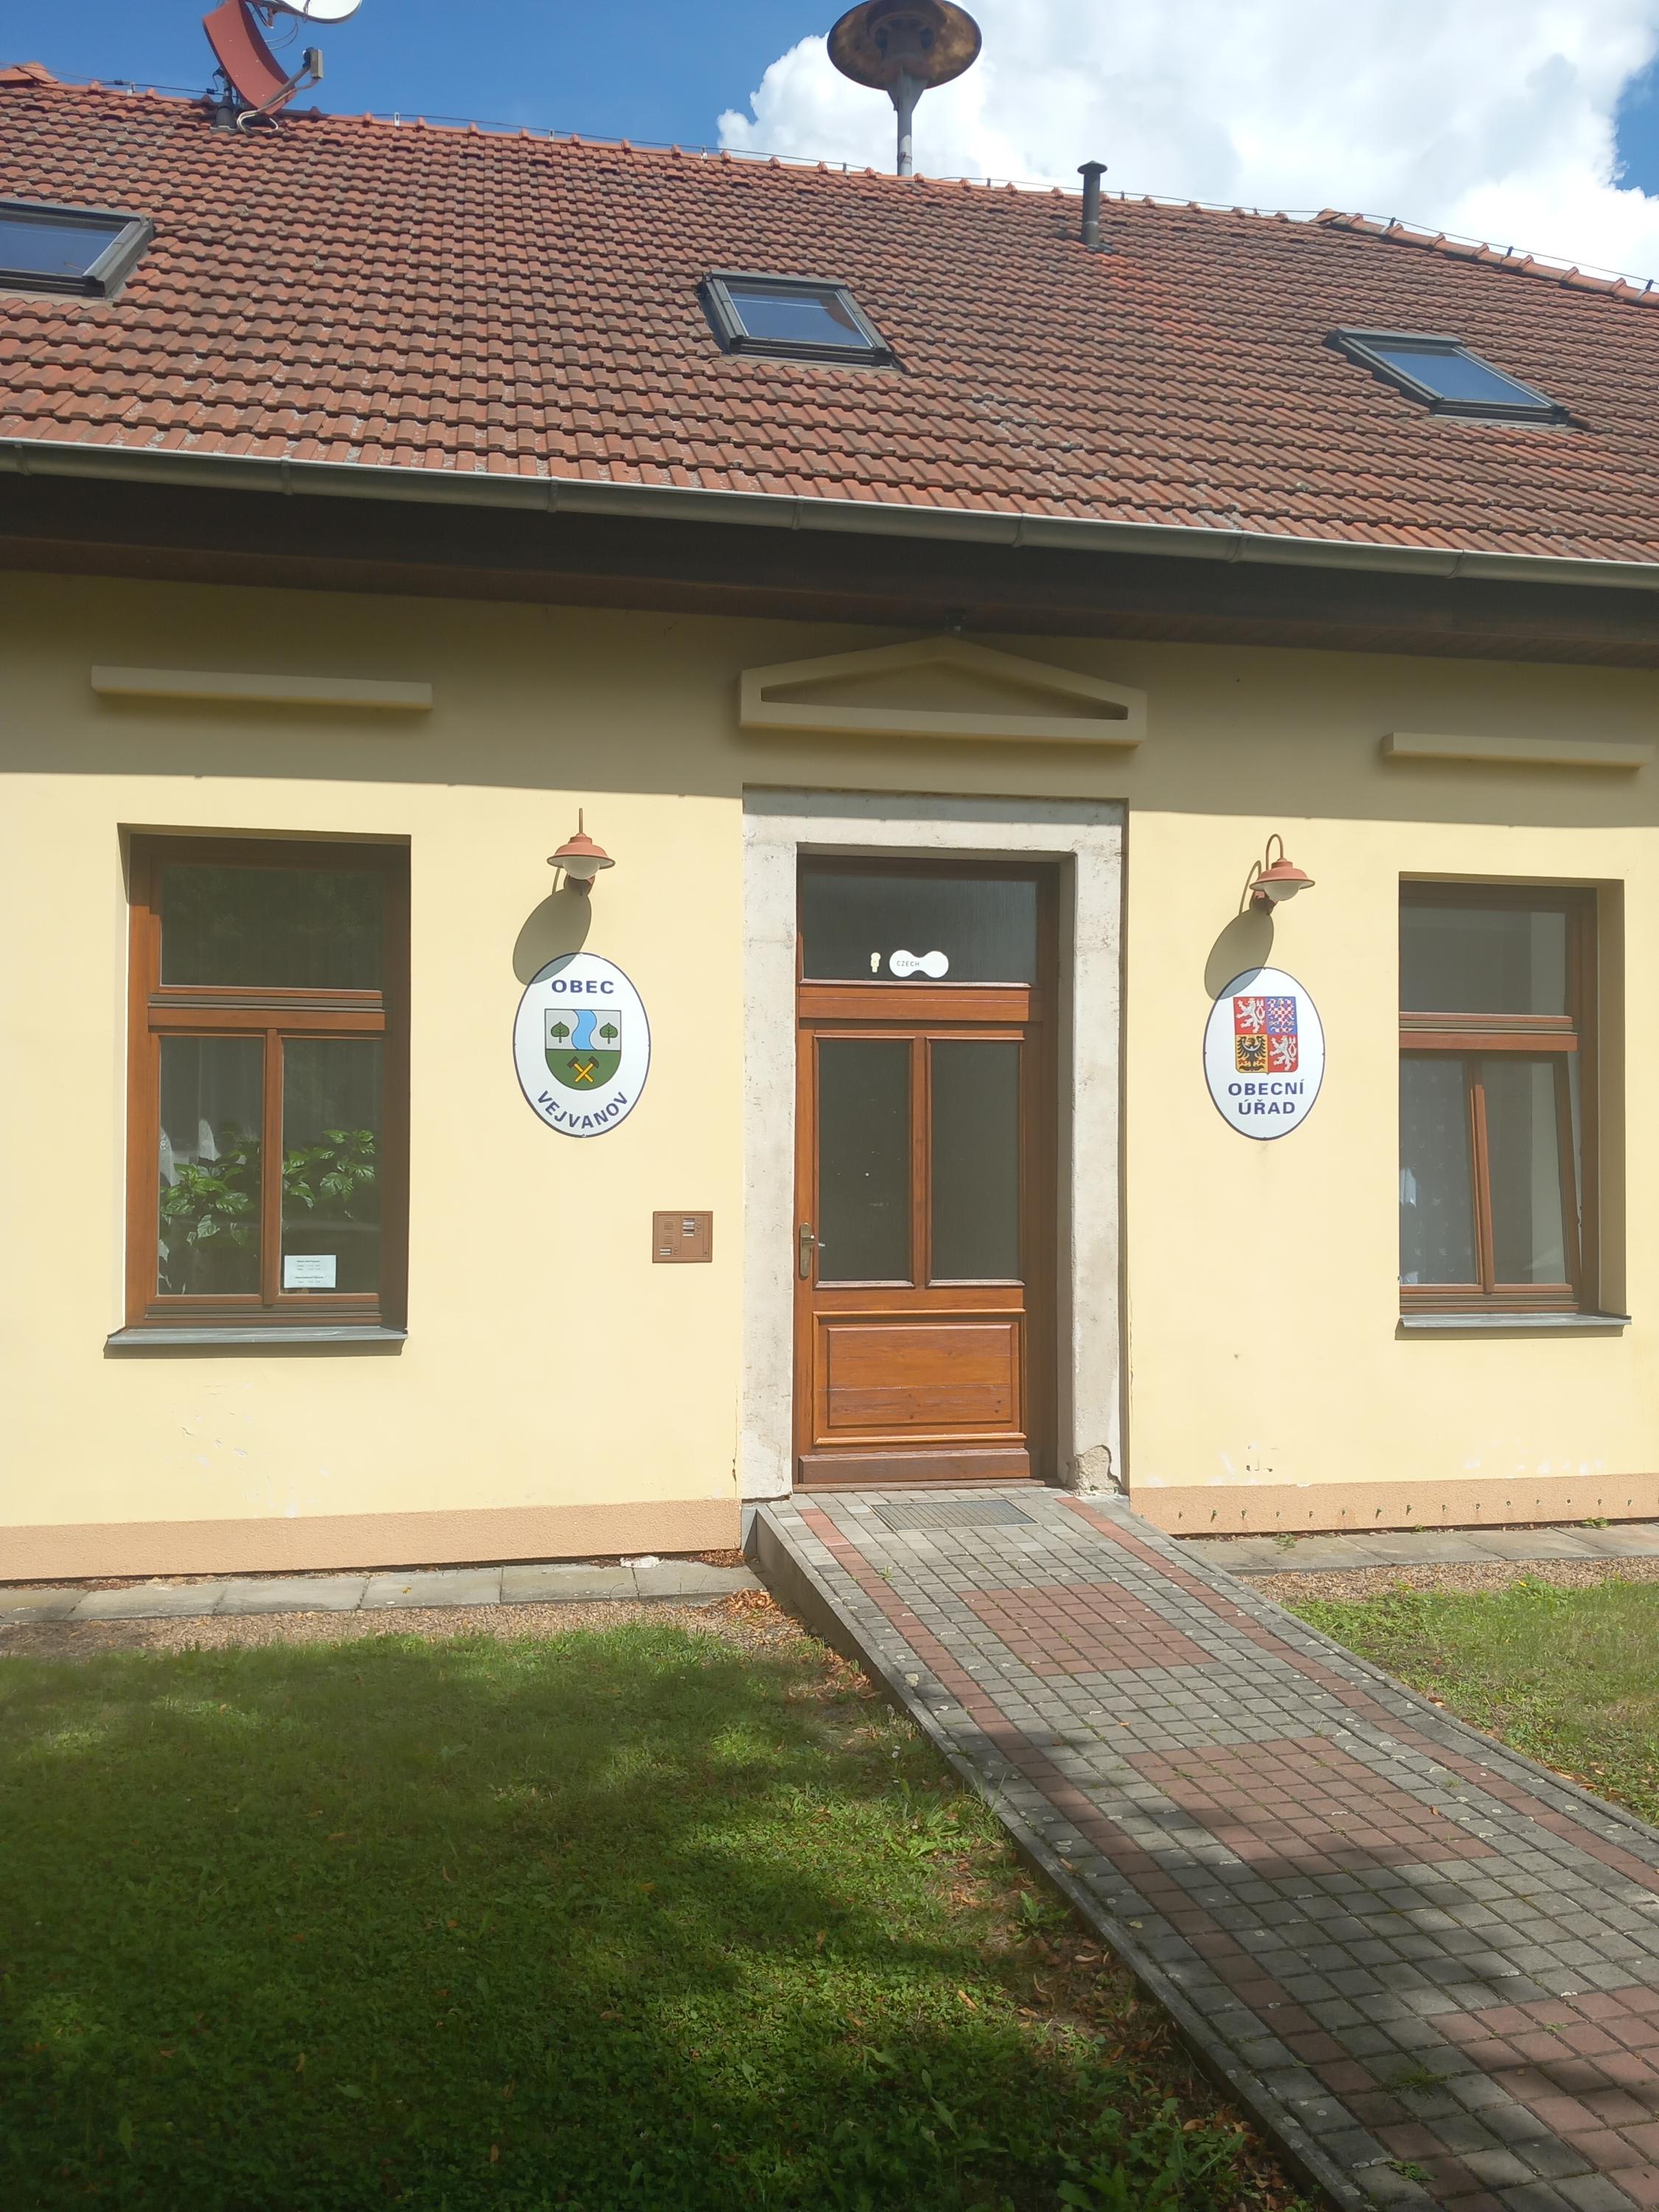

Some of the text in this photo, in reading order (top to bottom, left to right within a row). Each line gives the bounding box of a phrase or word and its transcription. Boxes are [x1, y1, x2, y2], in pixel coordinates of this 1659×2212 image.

[552, 979, 614, 994] OBEC
[1228, 1079, 1304, 1096] OBECNÍ
[538, 1091, 627, 1129] VEJVANOV
[1238, 1099, 1295, 1115] ÚŘAD
